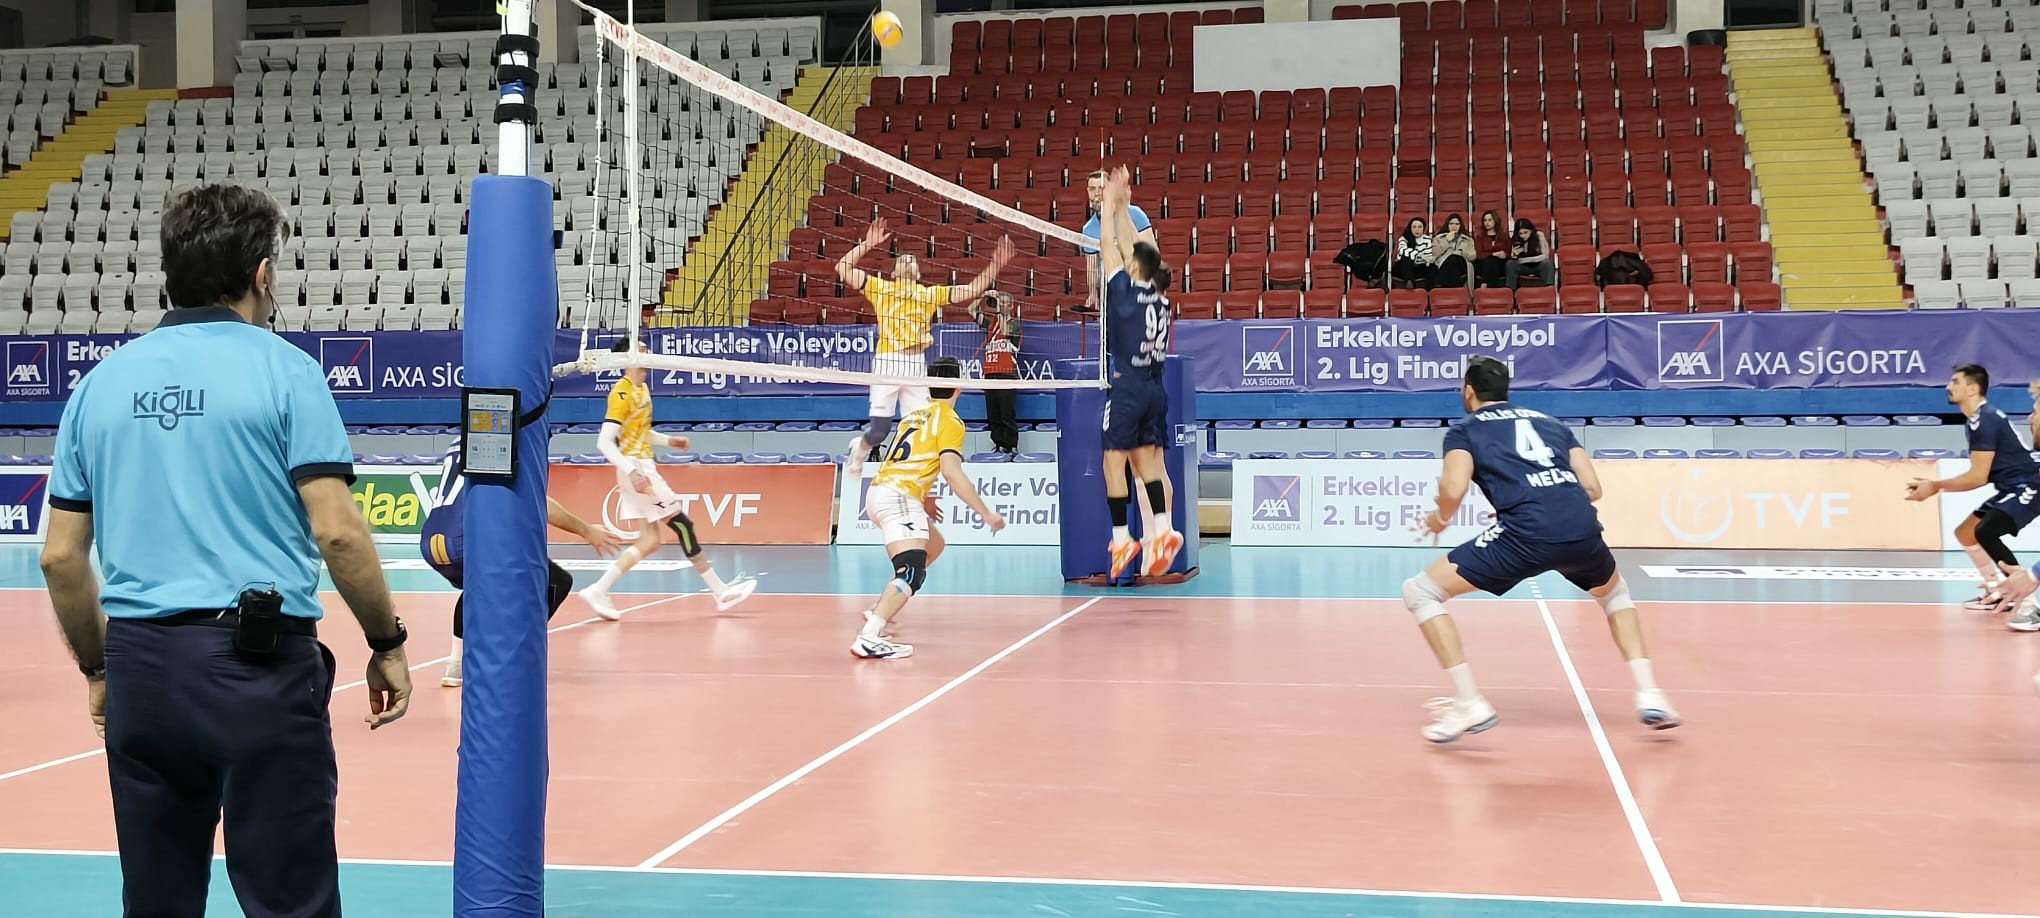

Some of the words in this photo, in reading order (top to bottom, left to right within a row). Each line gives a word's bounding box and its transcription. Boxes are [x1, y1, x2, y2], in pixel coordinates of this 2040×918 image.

[1145, 303, 1158, 341] 9
[662, 332, 761, 355] Erkekler
[766, 331, 875, 359] Voleybol
[1317, 324, 1427, 348] Erkekler
[1434, 323, 1555, 352] Voleybol
[67, 340, 120, 361] Erke
[1244, 352, 1285, 372] AXA
[1735, 351, 1791, 376] AXA
[1798, 346, 1927, 375] SİGORTA
[8, 364, 42, 382] AXA
[326, 365, 364, 387] AXA
[1317, 357, 1341, 380] 2.
[1349, 356, 1389, 385] Lig
[1397, 354, 1515, 379] Finali
[1660, 351, 1712, 376] AXA
[381, 366, 427, 388] AXA
[1241, 378, 1258, 387] AXA
[1259, 376, 1296, 387] SİGORTA
[1515, 419, 1555, 468] 4
[1029, 478, 1058, 497] Vo
[1323, 475, 1428, 497] Erkekler
[0, 504, 30, 530] XA
[675, 493, 761, 527] TVF
[1252, 498, 1292, 518] AXA
[1323, 505, 1345, 526] 2.
[1354, 505, 1391, 532] Lig
[1744, 492, 1850, 529] TVF
